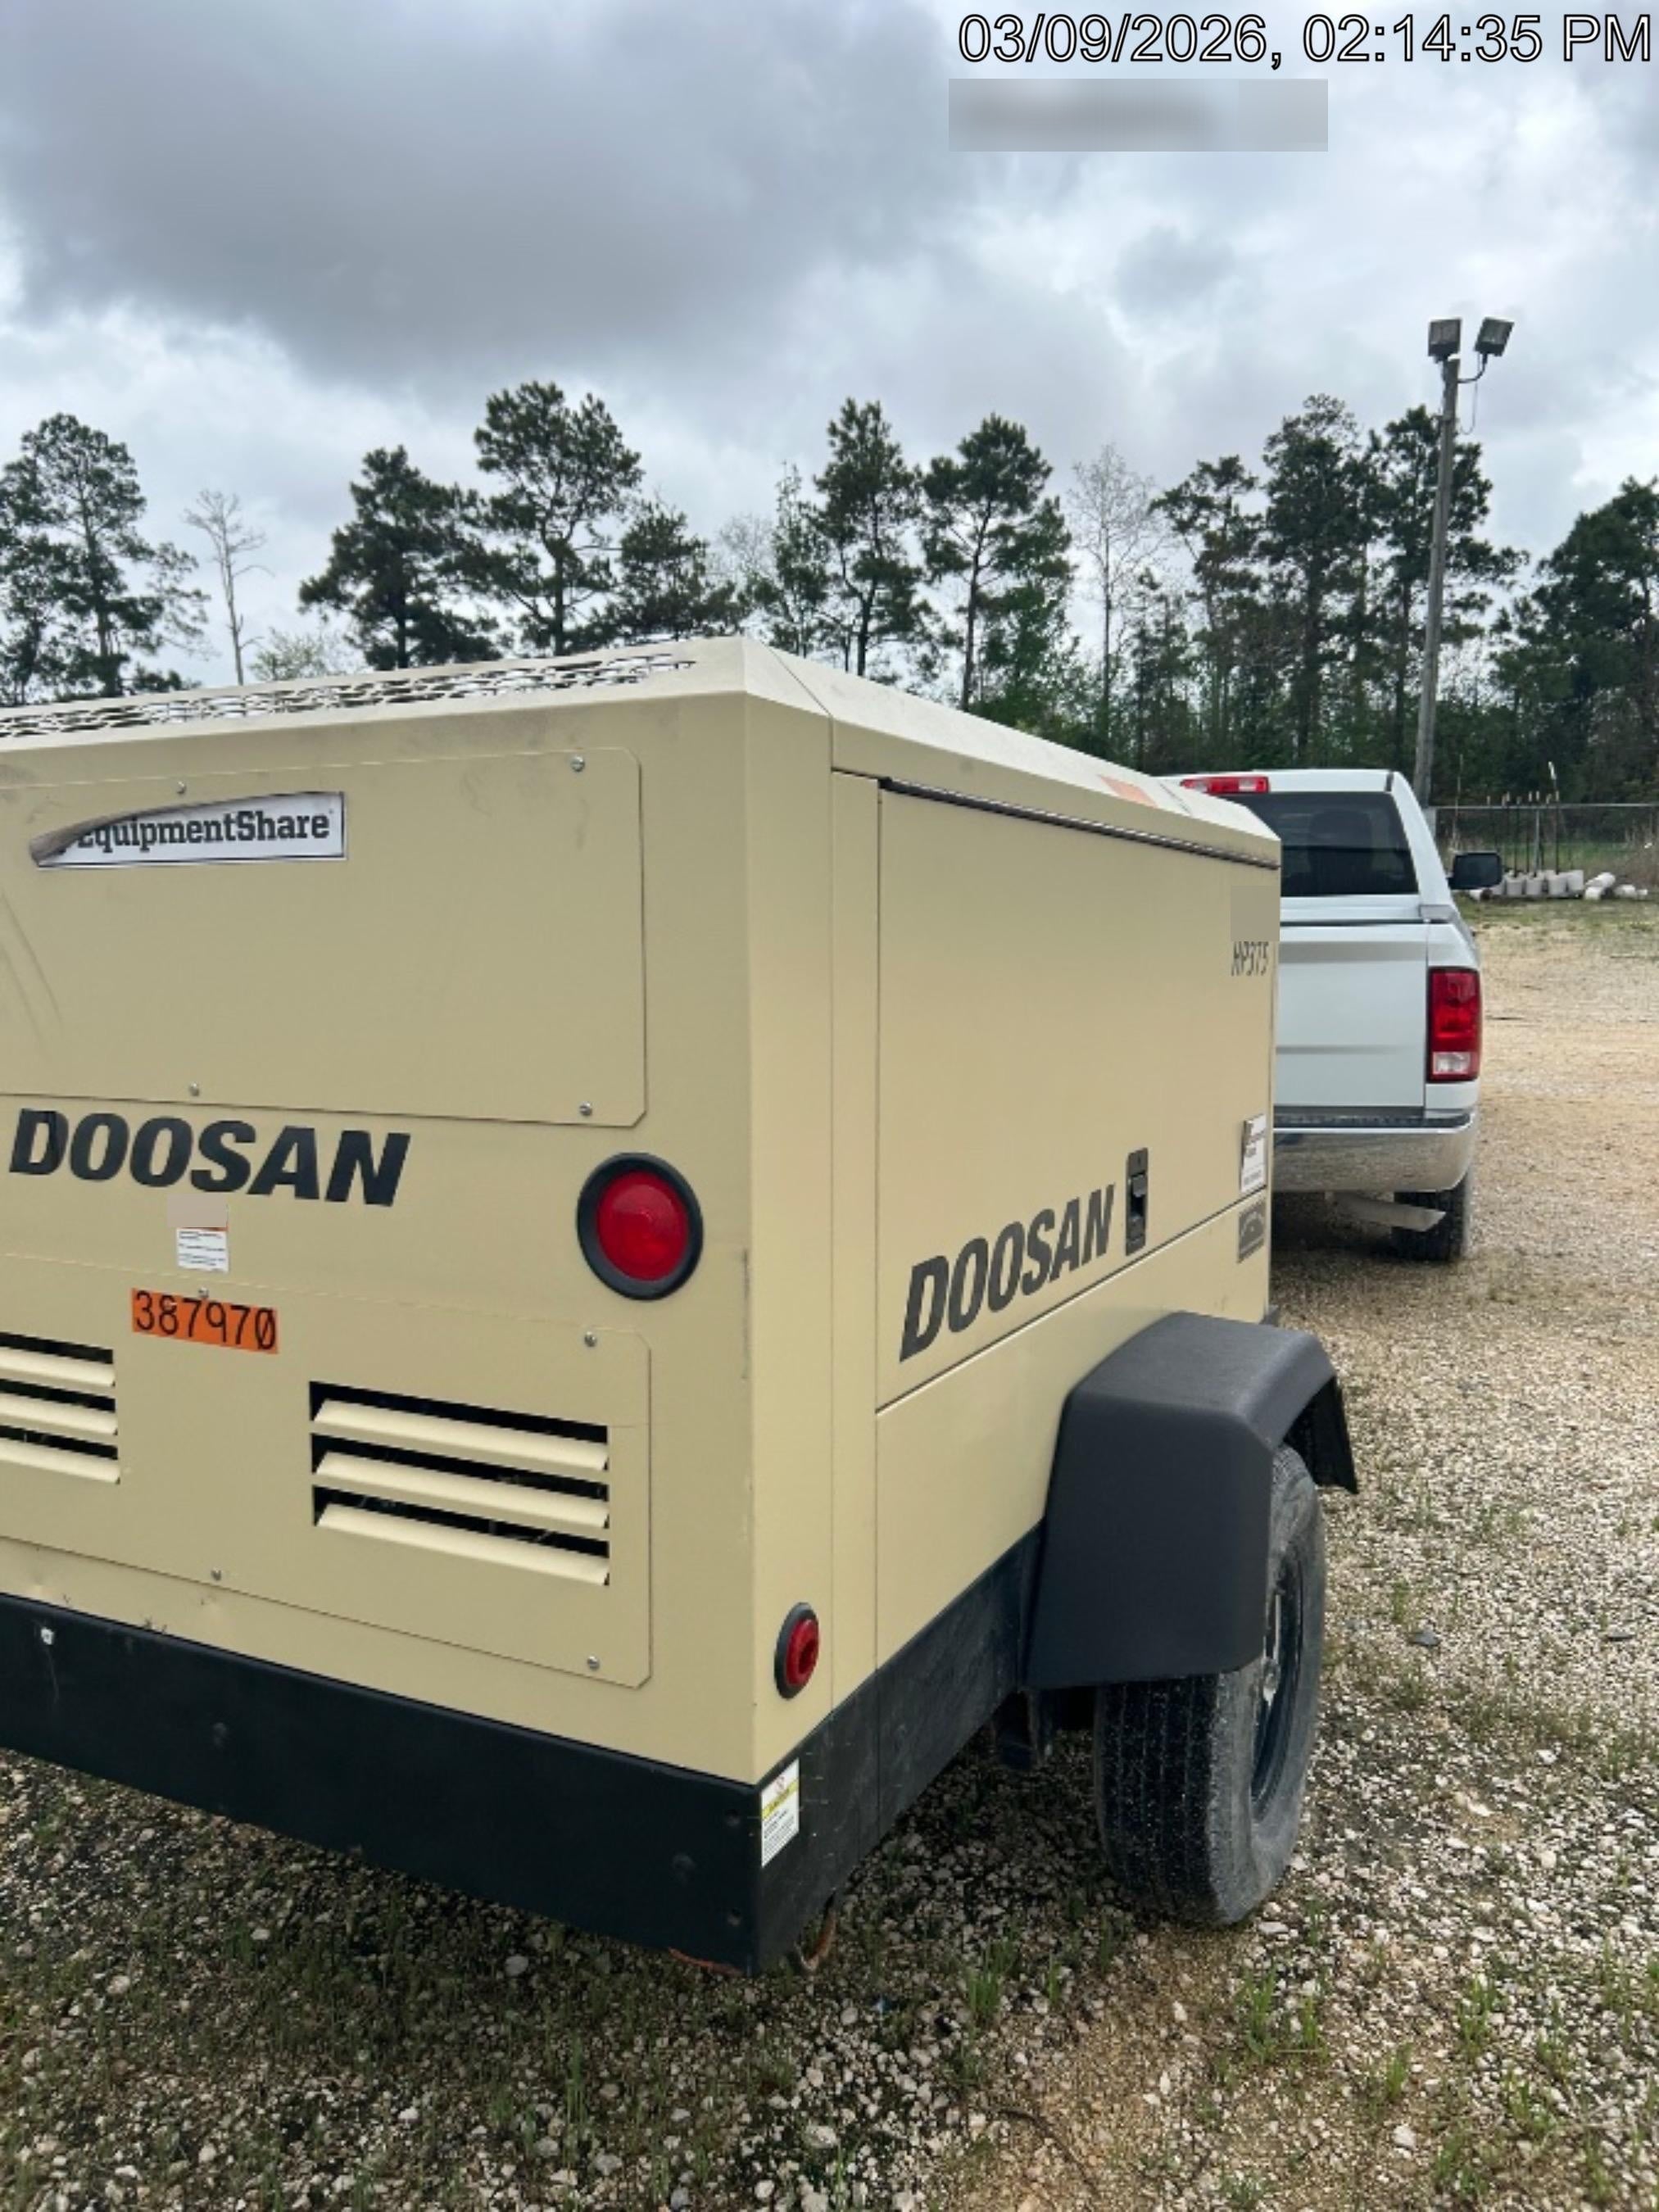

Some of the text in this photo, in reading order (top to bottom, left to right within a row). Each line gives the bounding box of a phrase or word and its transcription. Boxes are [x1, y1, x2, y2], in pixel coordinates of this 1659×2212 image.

[9, 1108, 410, 1207] DOOSAN
[135, 1290, 278, 1350] 387970
[899, 1182, 1115, 1362] DOOSAN
